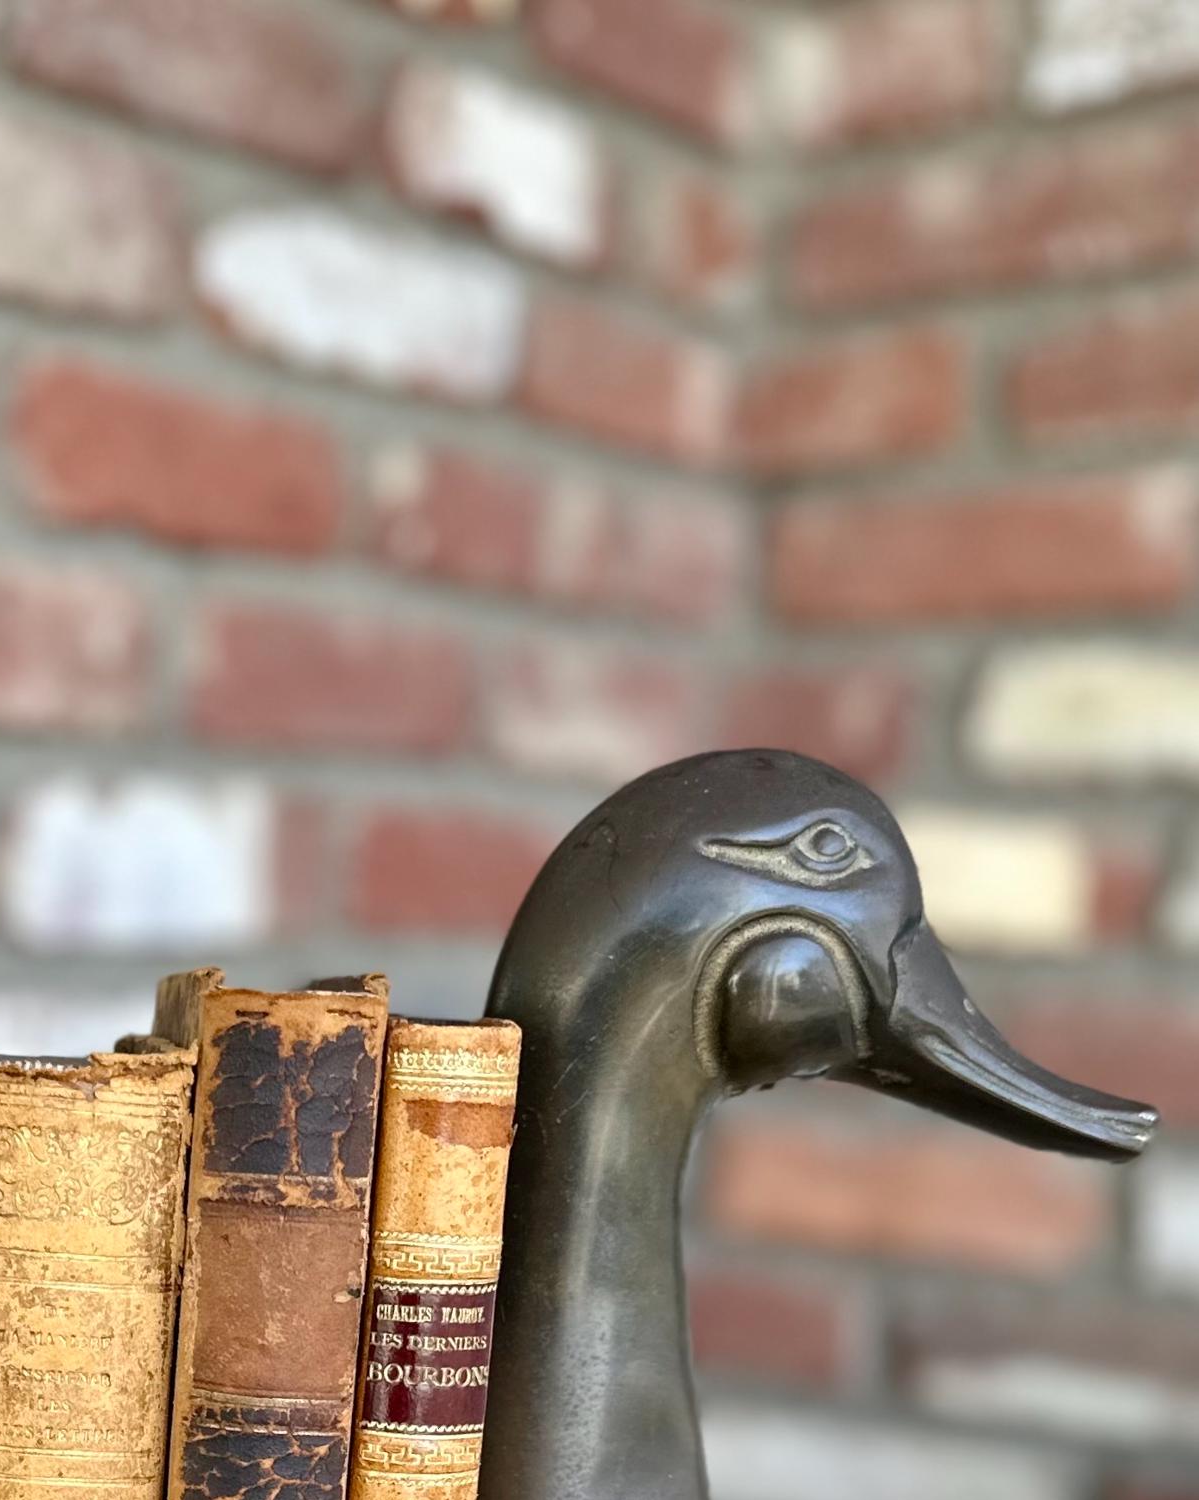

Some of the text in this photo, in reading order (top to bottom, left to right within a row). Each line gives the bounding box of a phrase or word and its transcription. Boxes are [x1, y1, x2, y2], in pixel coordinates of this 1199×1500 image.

[376, 1303, 434, 1323] CHARLES
[370, 1331, 488, 1351] LES DERNIERS
